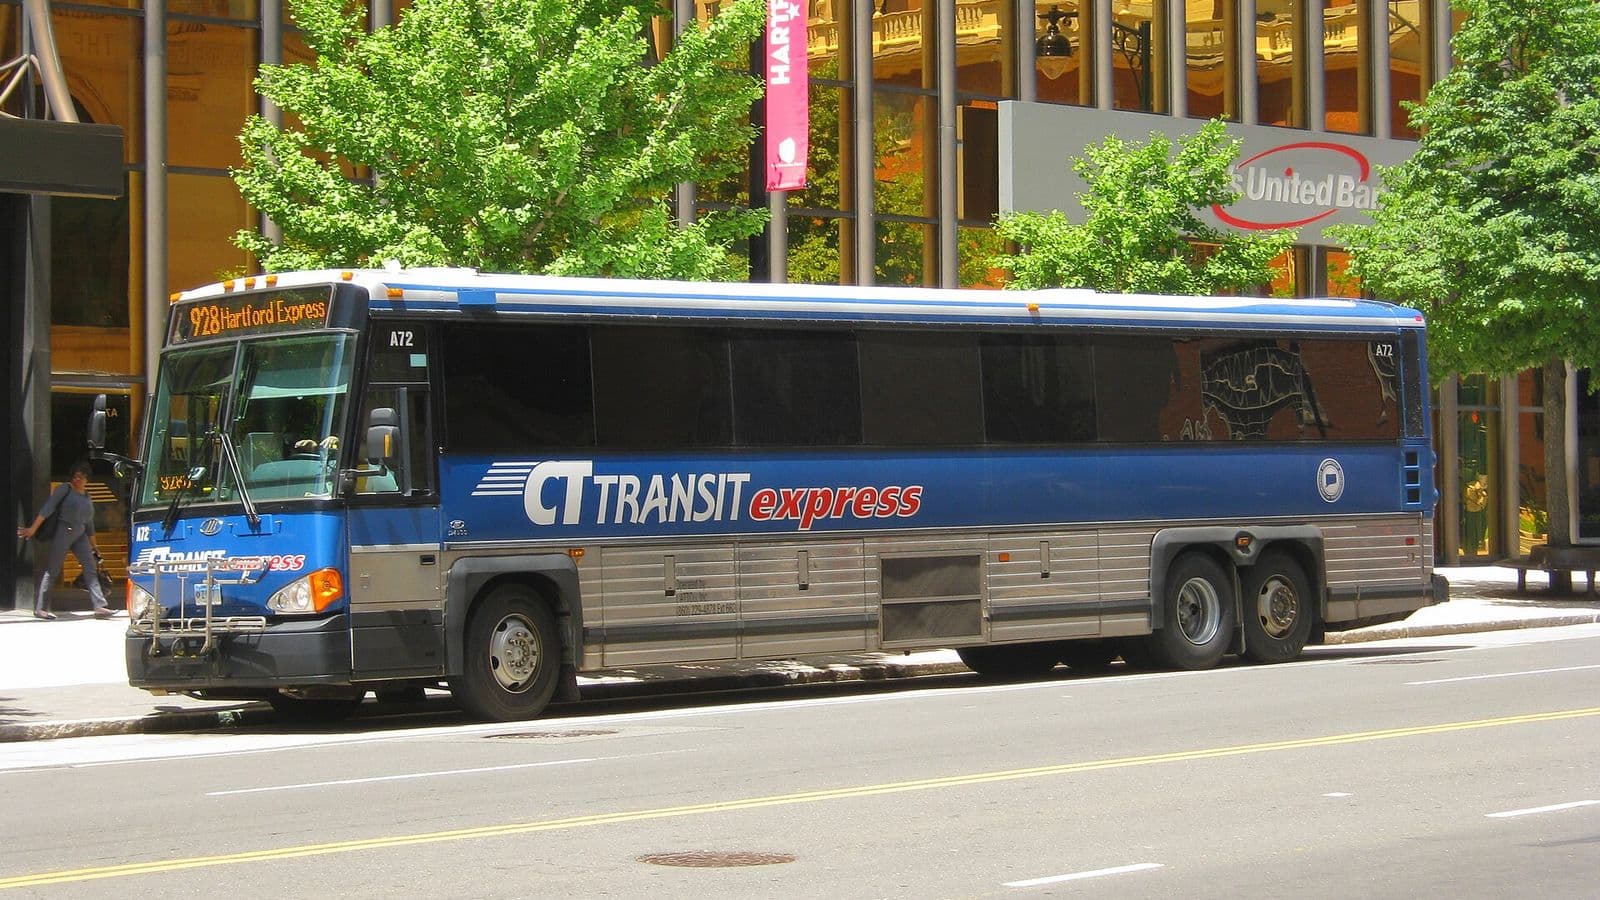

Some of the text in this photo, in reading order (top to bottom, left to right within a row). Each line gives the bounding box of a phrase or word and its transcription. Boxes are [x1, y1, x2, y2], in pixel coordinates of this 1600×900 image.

[1247, 166, 1334, 206] United
[190, 300, 326, 337] 928 Hartford Express
[389, 330, 414, 347] A72
[1375, 344, 1393, 356] A72
[749, 485, 923, 531] express
[136, 526, 150, 542] A72
